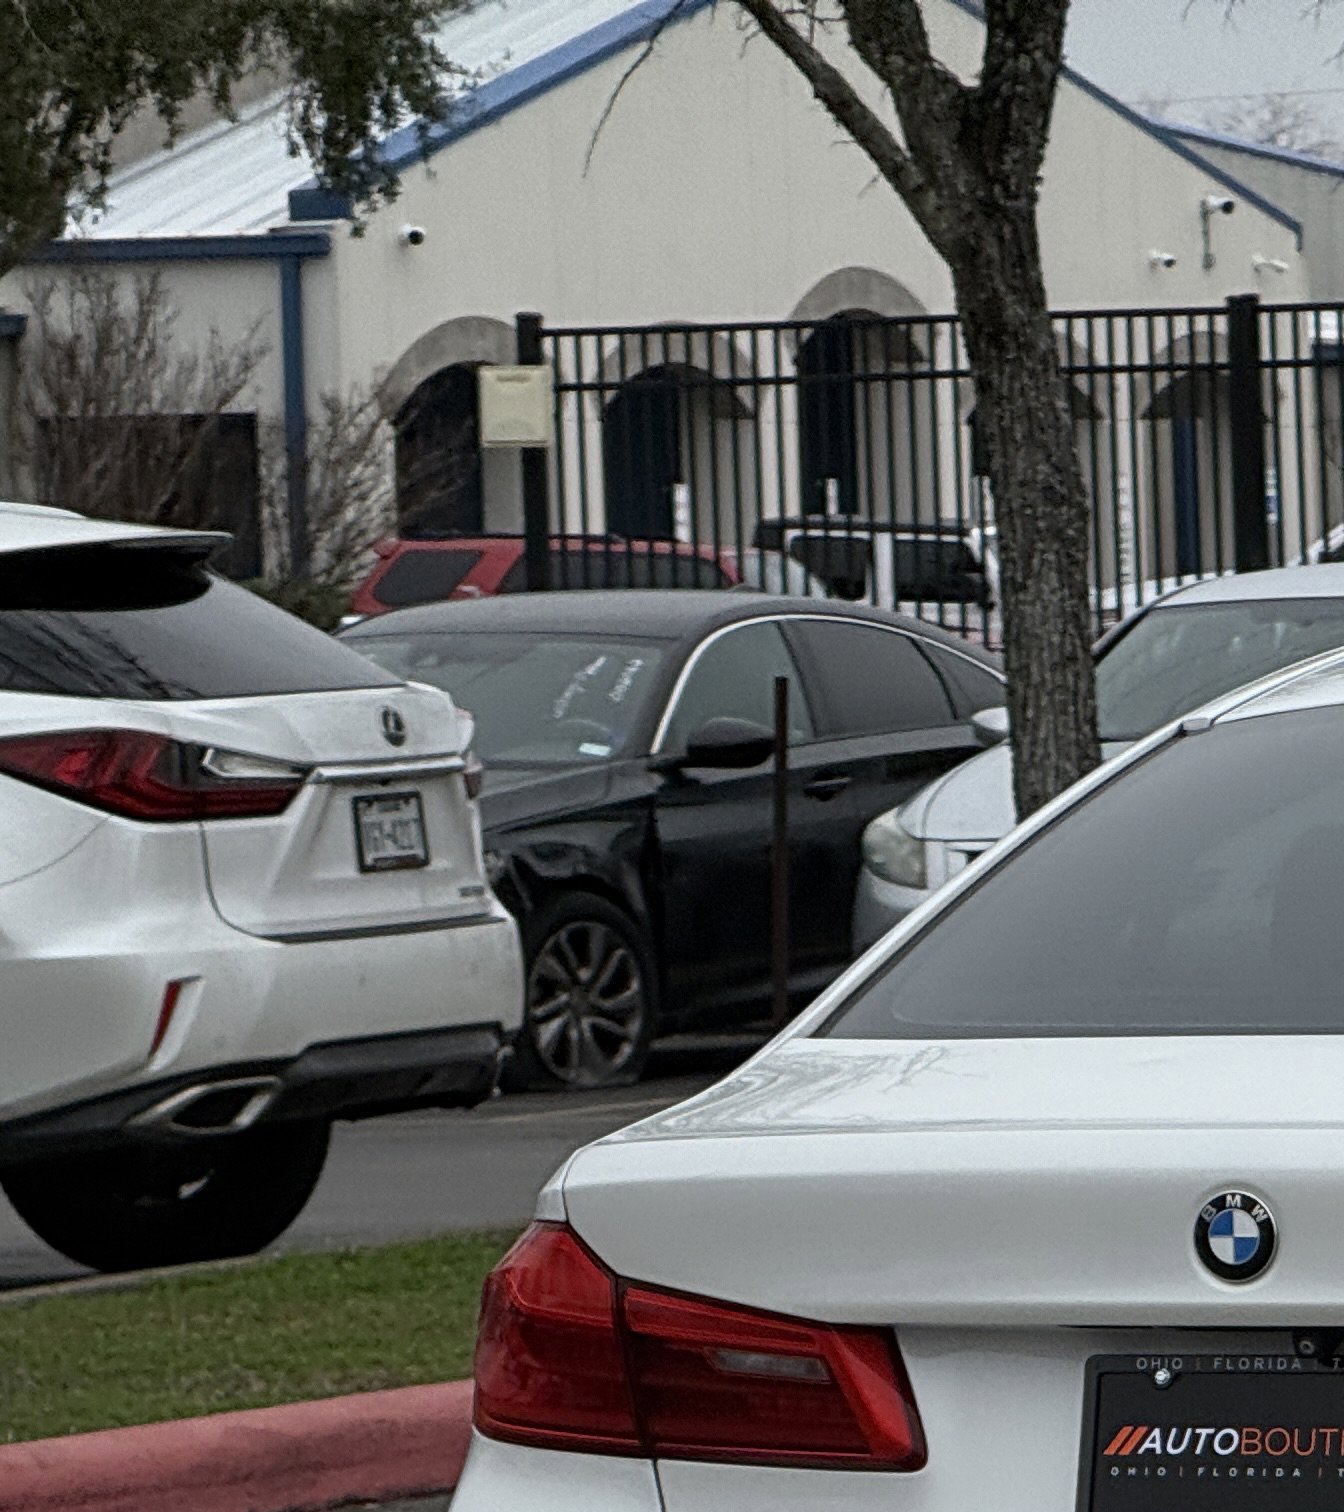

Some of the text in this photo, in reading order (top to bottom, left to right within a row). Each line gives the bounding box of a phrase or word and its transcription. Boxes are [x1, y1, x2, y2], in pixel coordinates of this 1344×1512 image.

[1200, 1194, 1269, 1223] BMW
[1136, 1357, 1183, 1371] OHIO
[1213, 1357, 1301, 1371] FLORIDA
[1110, 1466, 1166, 1477] OHIO
[1197, 1466, 1301, 1478] FLORIDA
